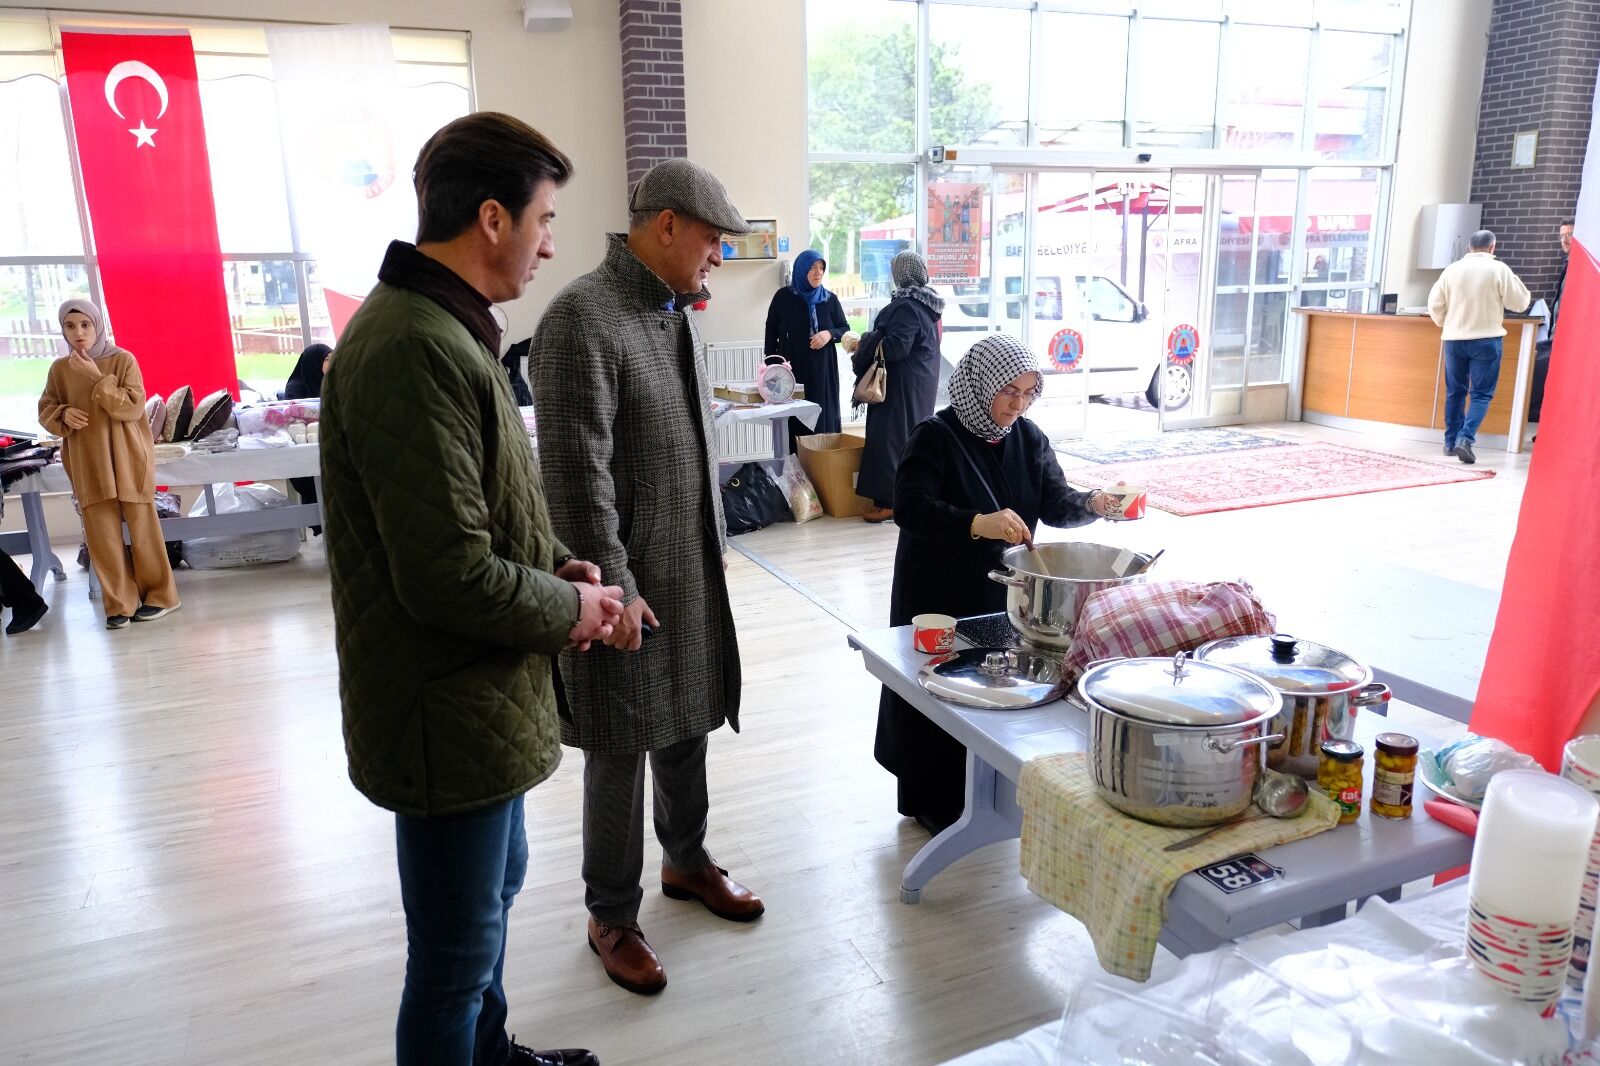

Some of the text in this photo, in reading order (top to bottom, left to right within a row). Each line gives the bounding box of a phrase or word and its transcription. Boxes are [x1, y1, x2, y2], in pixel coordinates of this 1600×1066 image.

[1174, 238, 1197, 246] AFRA
[1006, 246, 1023, 257] BAF
[1207, 864, 1252, 889] 58
